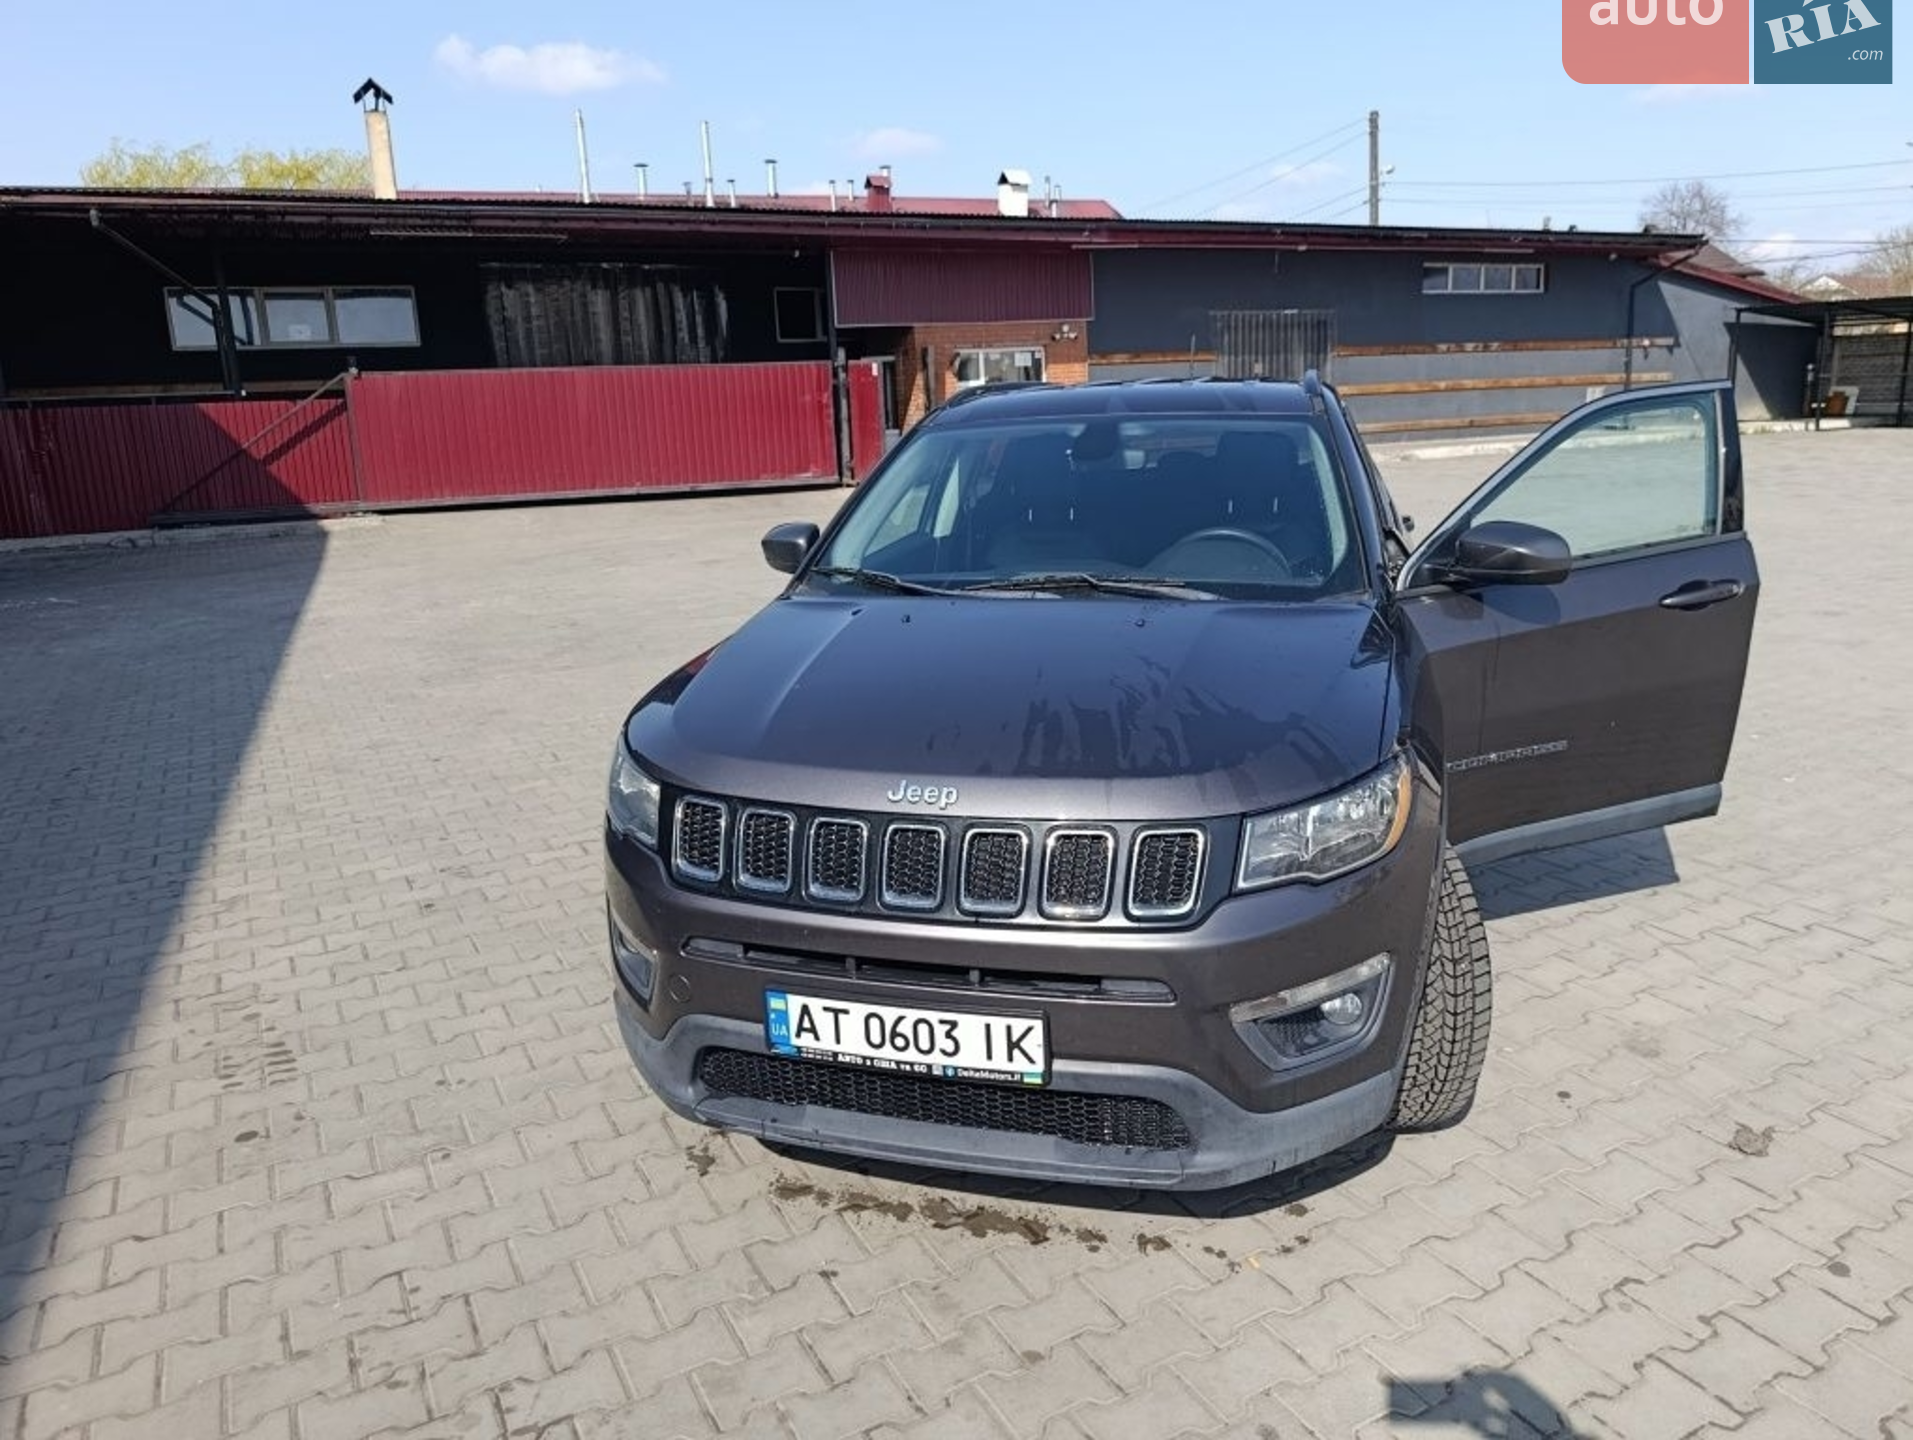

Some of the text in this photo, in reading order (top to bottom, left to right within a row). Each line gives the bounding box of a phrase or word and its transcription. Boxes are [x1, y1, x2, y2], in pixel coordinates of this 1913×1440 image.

[887, 779, 959, 810] Jeep
[771, 1022, 789, 1037] UA
[794, 1002, 1037, 1065] AT 0603 IK
